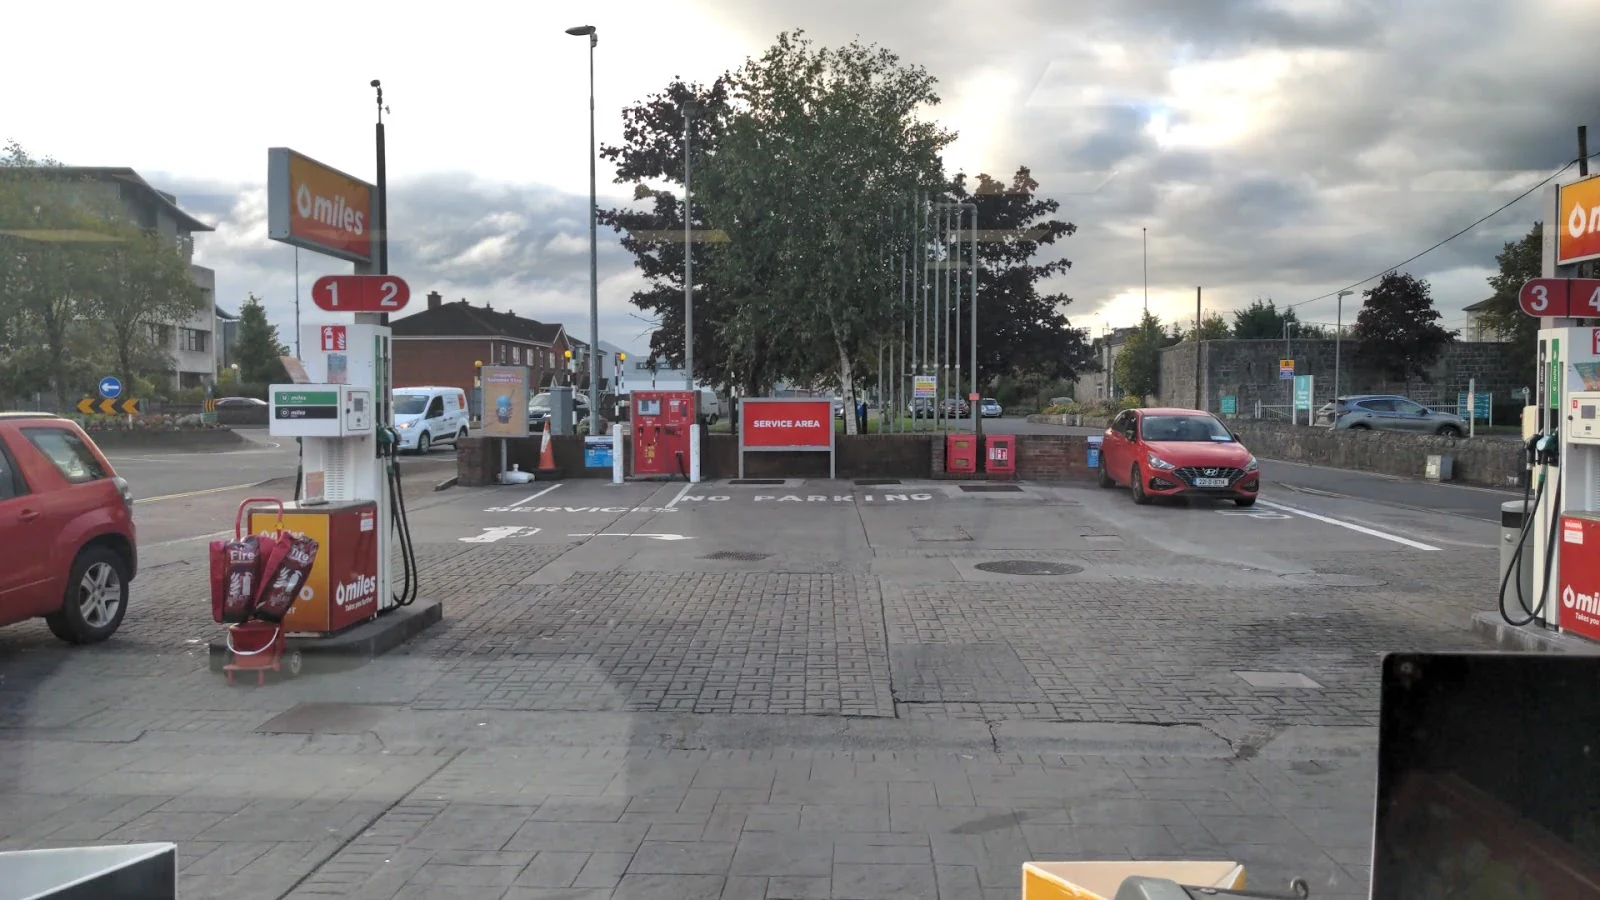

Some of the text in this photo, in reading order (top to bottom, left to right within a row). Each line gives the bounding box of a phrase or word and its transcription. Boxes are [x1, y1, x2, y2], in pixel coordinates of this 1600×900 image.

[314, 195, 364, 235] miles
[326, 281, 339, 306] 1
[380, 281, 398, 306] 2
[1531, 285, 1548, 311] 3
[1588, 286, 1600, 313] 4
[754, 420, 820, 428] SERVICE AREA
[754, 493, 933, 502] PARKING
[230, 550, 256, 561] Fire
[345, 574, 376, 602] miles
[1575, 612, 1600, 626] Takes you
